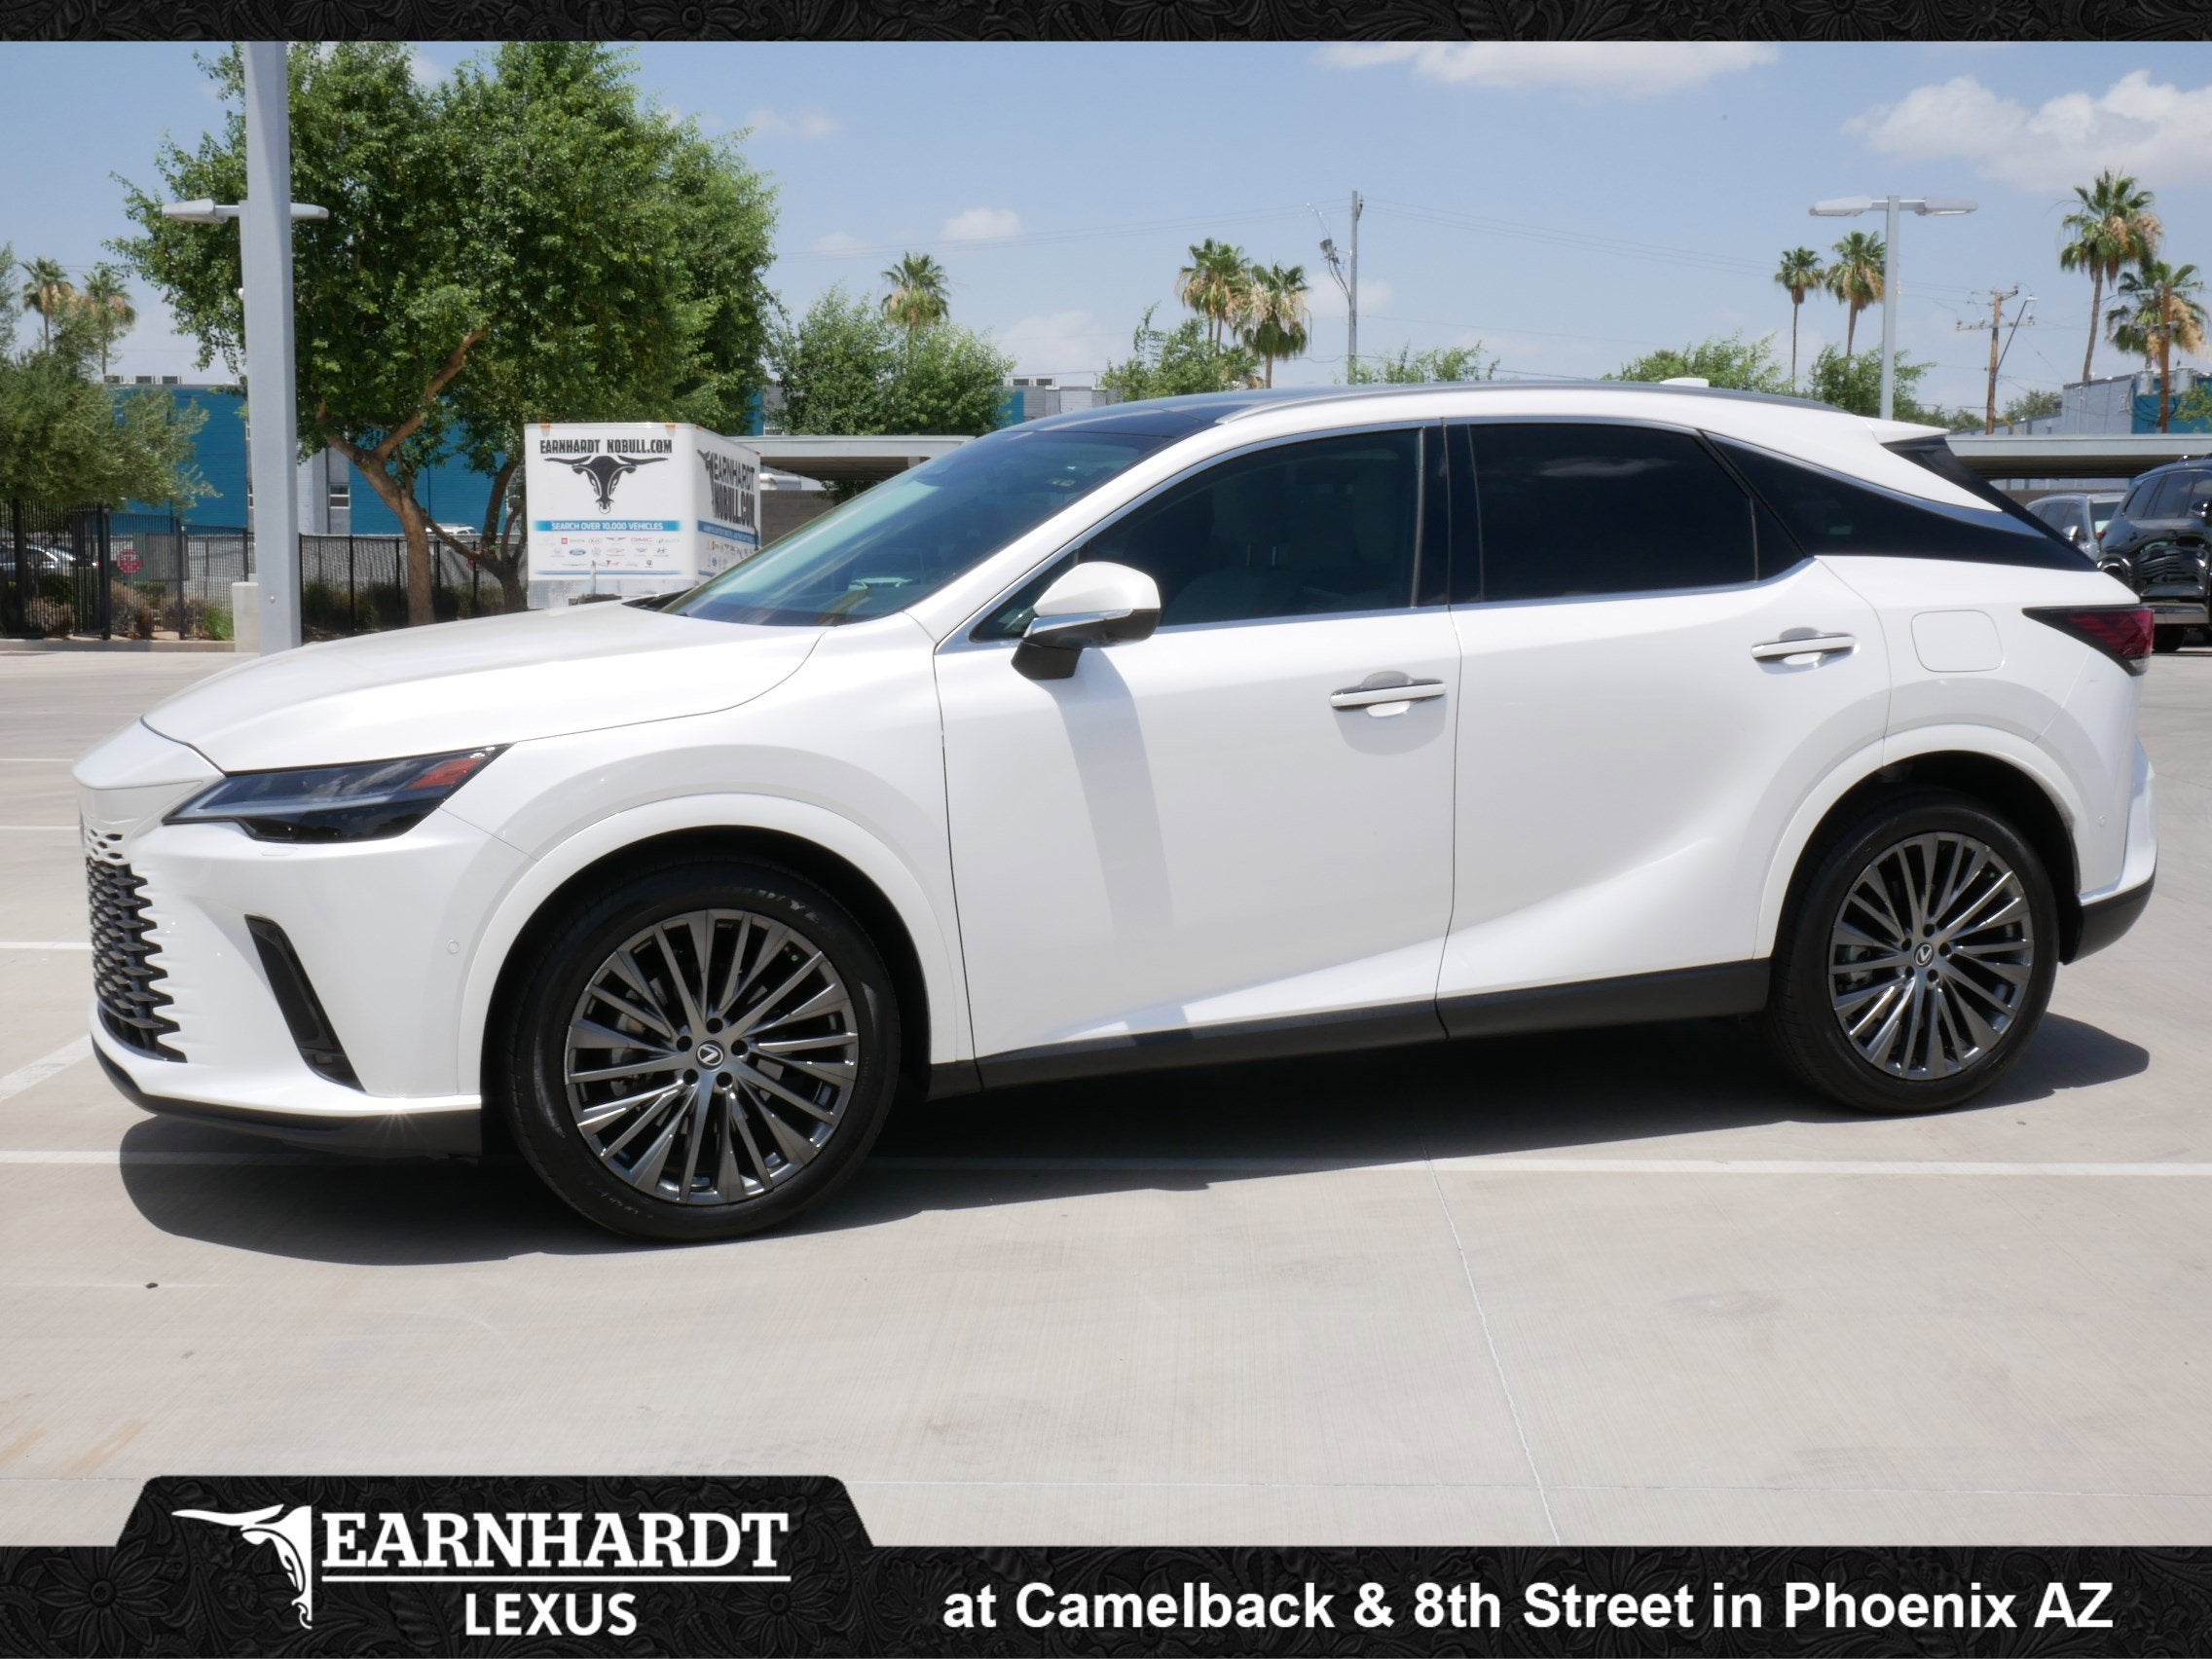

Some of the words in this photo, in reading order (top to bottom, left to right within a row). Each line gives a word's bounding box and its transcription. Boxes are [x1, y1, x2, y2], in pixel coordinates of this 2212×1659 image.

[540, 439, 601, 454] EARNHARDT
[607, 439, 673, 454] NOBULL.COM
[713, 452, 756, 492] EARNHARDT
[551, 522, 579, 531] SEARCH
[580, 522, 600, 531] OVER
[628, 522, 664, 531] VEHICLES
